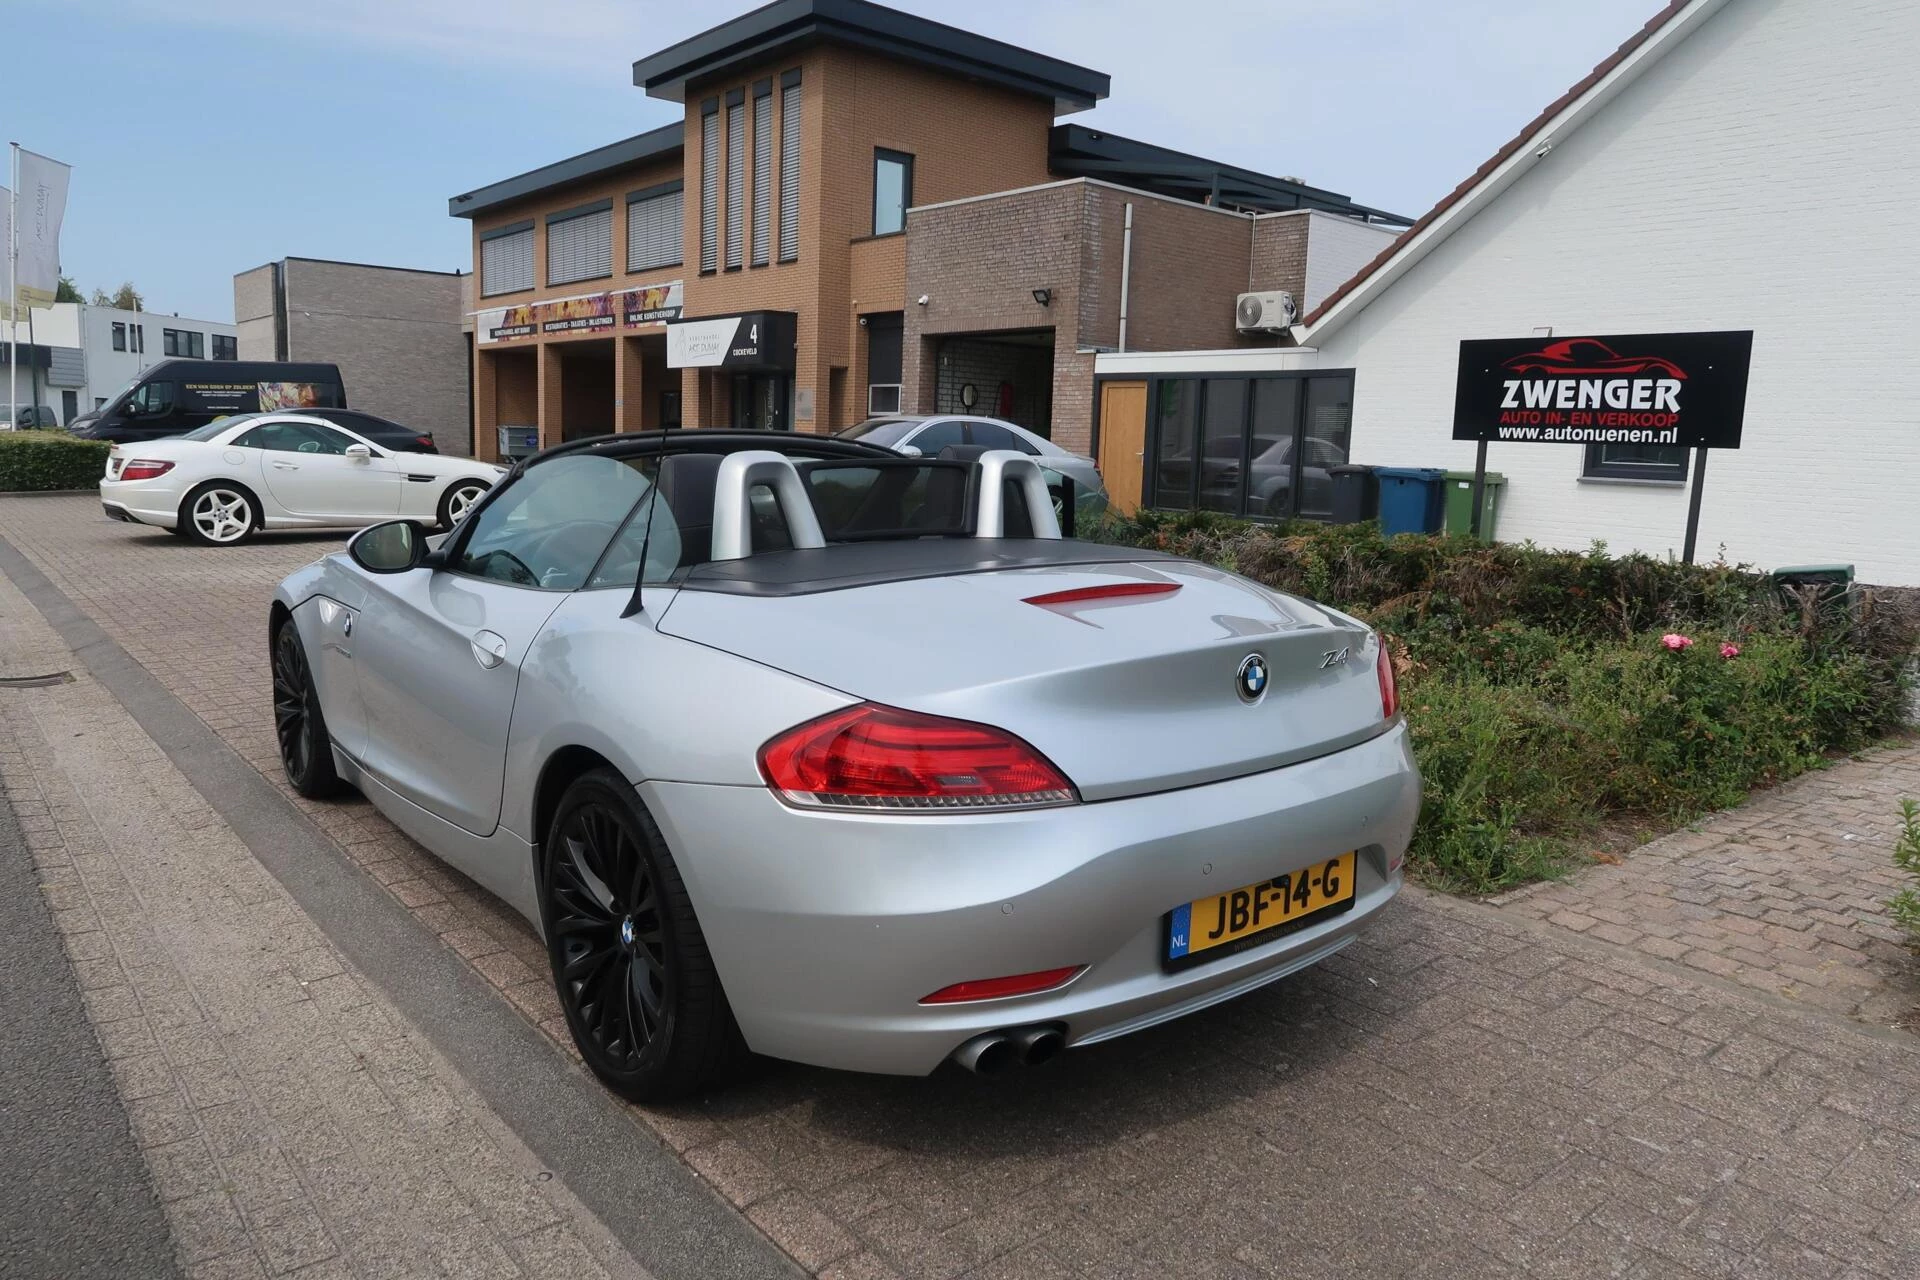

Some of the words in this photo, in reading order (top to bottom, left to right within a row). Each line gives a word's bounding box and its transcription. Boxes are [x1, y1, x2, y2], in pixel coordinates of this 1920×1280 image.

[750, 324, 758, 344] 4
[732, 347, 758, 356] COCKEVELD
[1500, 378, 1682, 413] ZWENGER
[1500, 411, 1540, 424] AUTO
[1545, 411, 1566, 425] IN-
[1571, 412, 1592, 425] EN
[1598, 412, 1680, 427] VERKOOP
[1498, 425, 1678, 443] www.autonuenen.nl
[1319, 646, 1350, 669] Z4
[1208, 859, 1340, 940] JBF-14-G
[1172, 935, 1187, 948] NL
